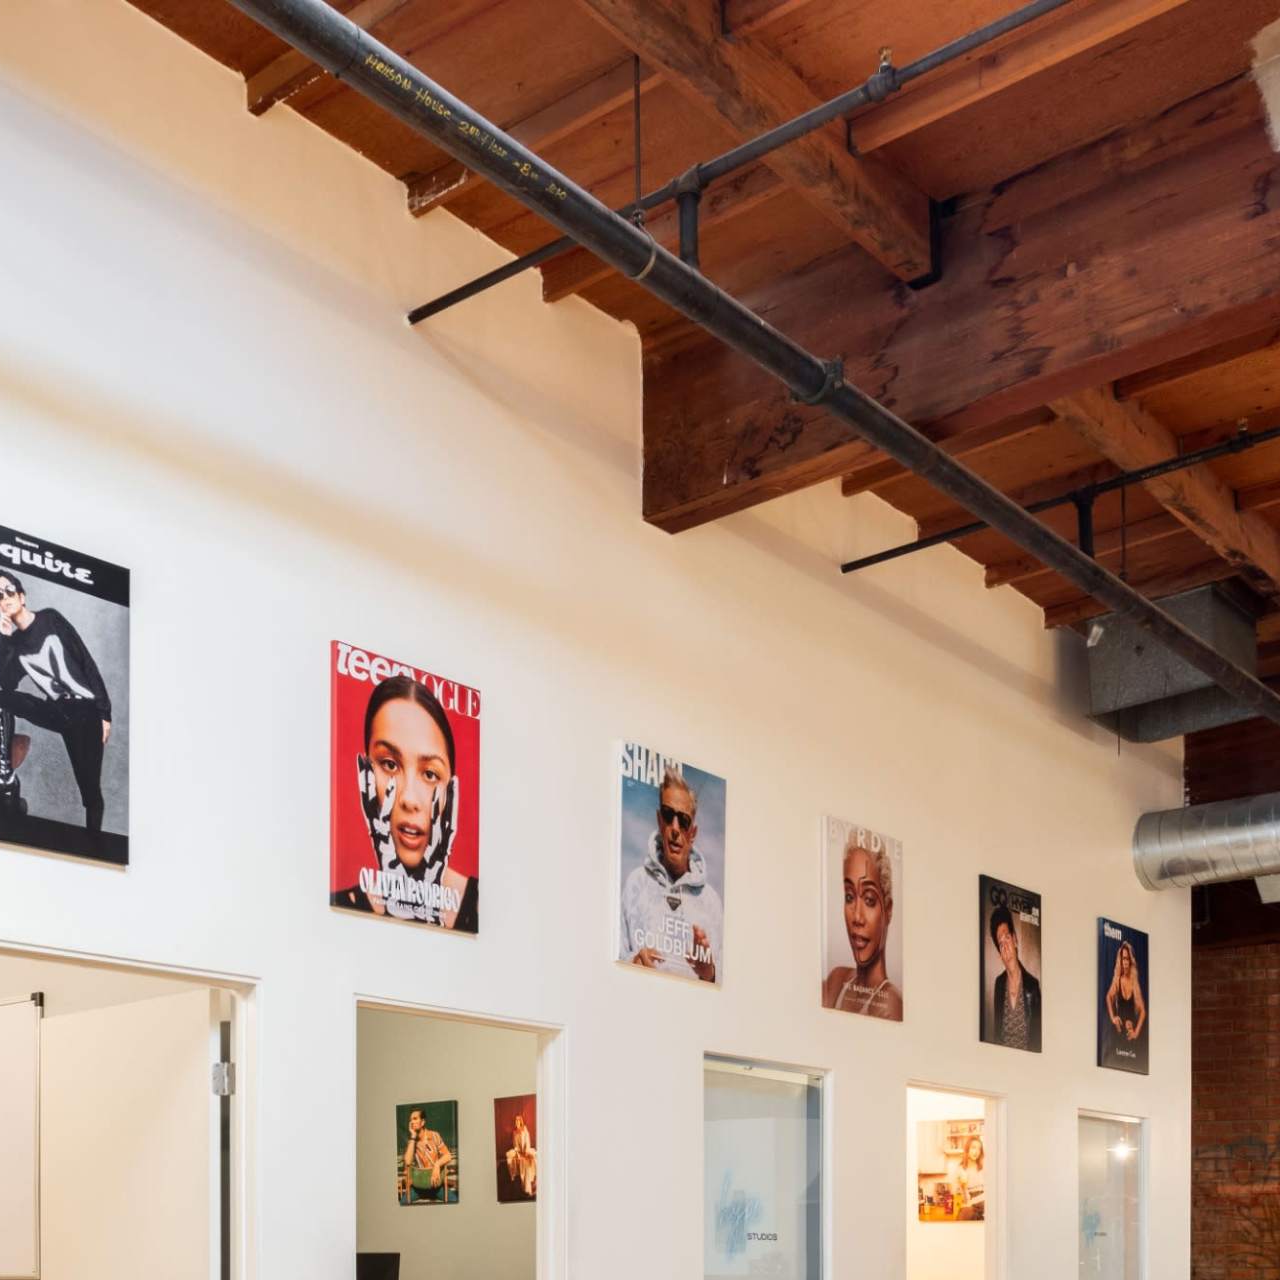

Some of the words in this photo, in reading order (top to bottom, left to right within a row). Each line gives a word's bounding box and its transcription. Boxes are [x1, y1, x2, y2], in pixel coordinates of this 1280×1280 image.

[411, 667, 480, 719] OGUE
[359, 867, 406, 902] OLIVIA
[406, 876, 460, 912] RODRIGO
[635, 928, 712, 964] GOLDBLUM
[658, 917, 689, 940] JEFF
